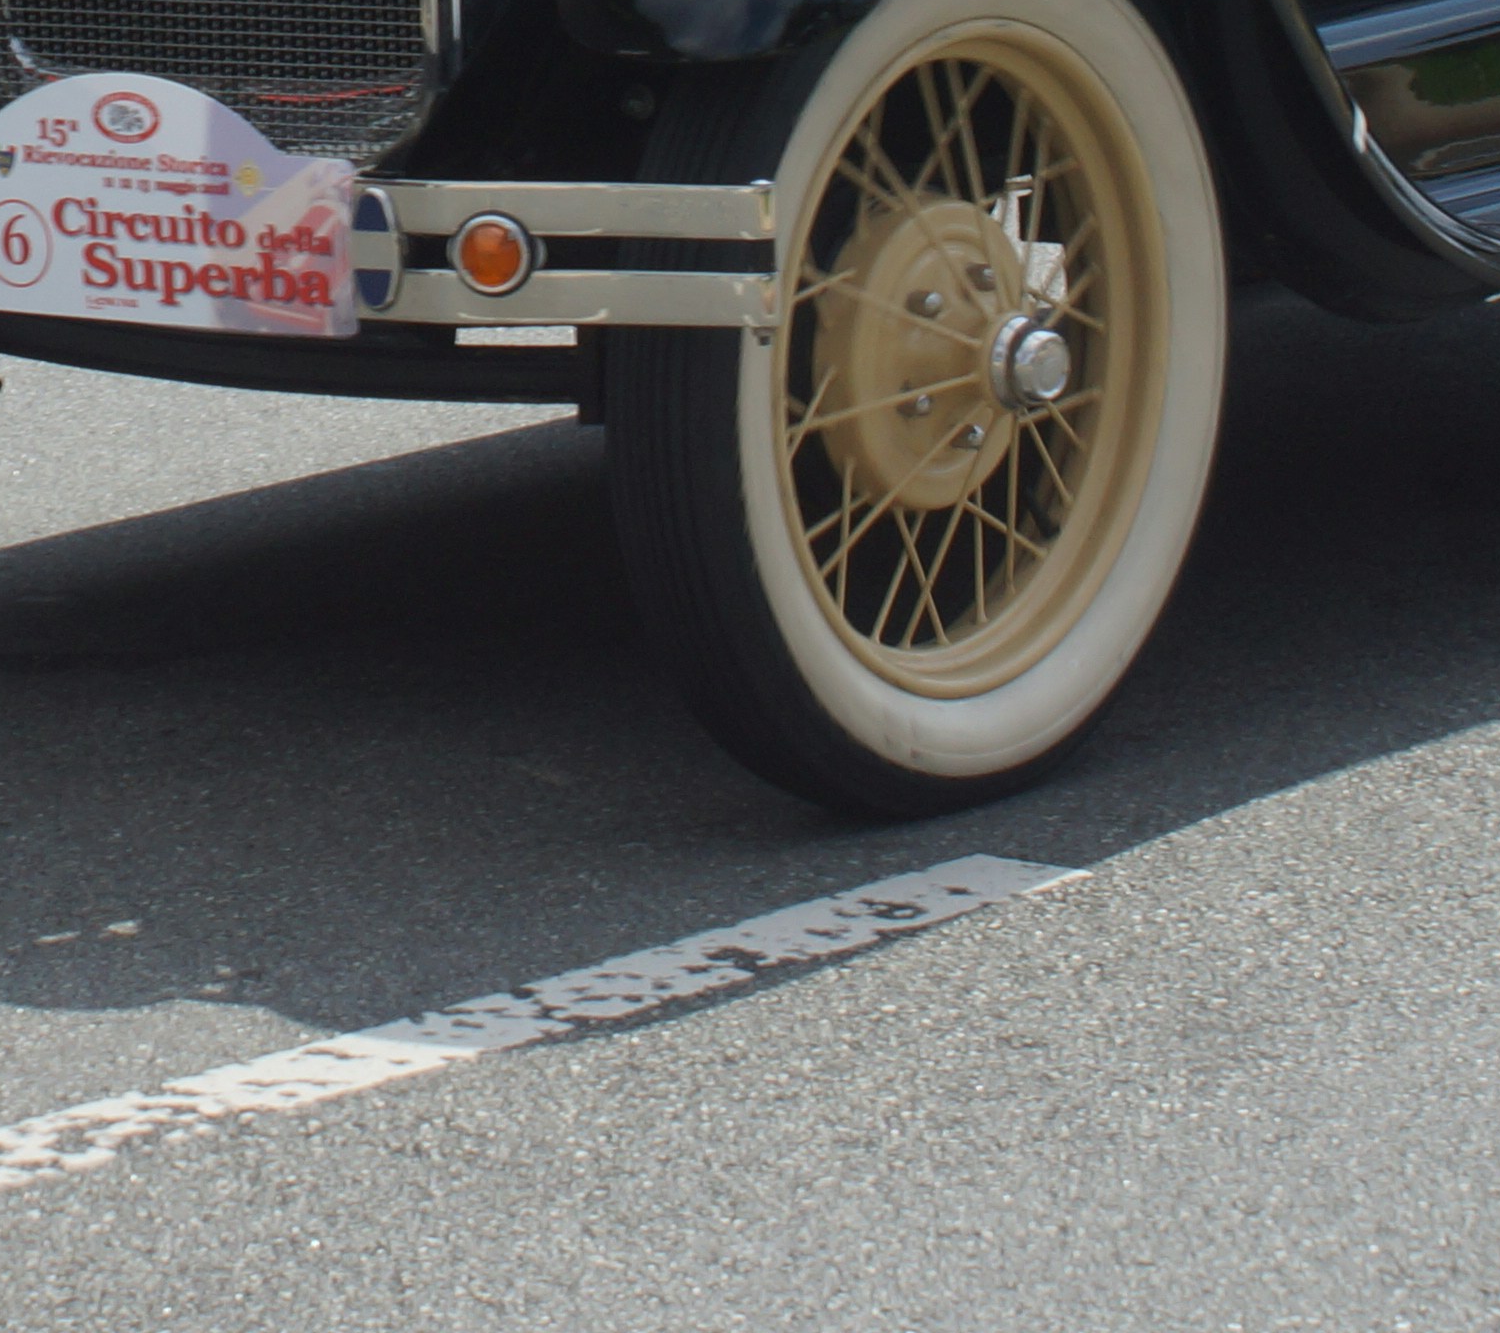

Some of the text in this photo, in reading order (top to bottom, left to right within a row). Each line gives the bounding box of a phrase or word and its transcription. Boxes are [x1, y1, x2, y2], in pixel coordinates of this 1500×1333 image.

[22, 144, 229, 176] Rievocazione Storica
[2, 213, 31, 266] 6
[51, 196, 335, 256] Circuito della
[81, 242, 335, 308] Superba
